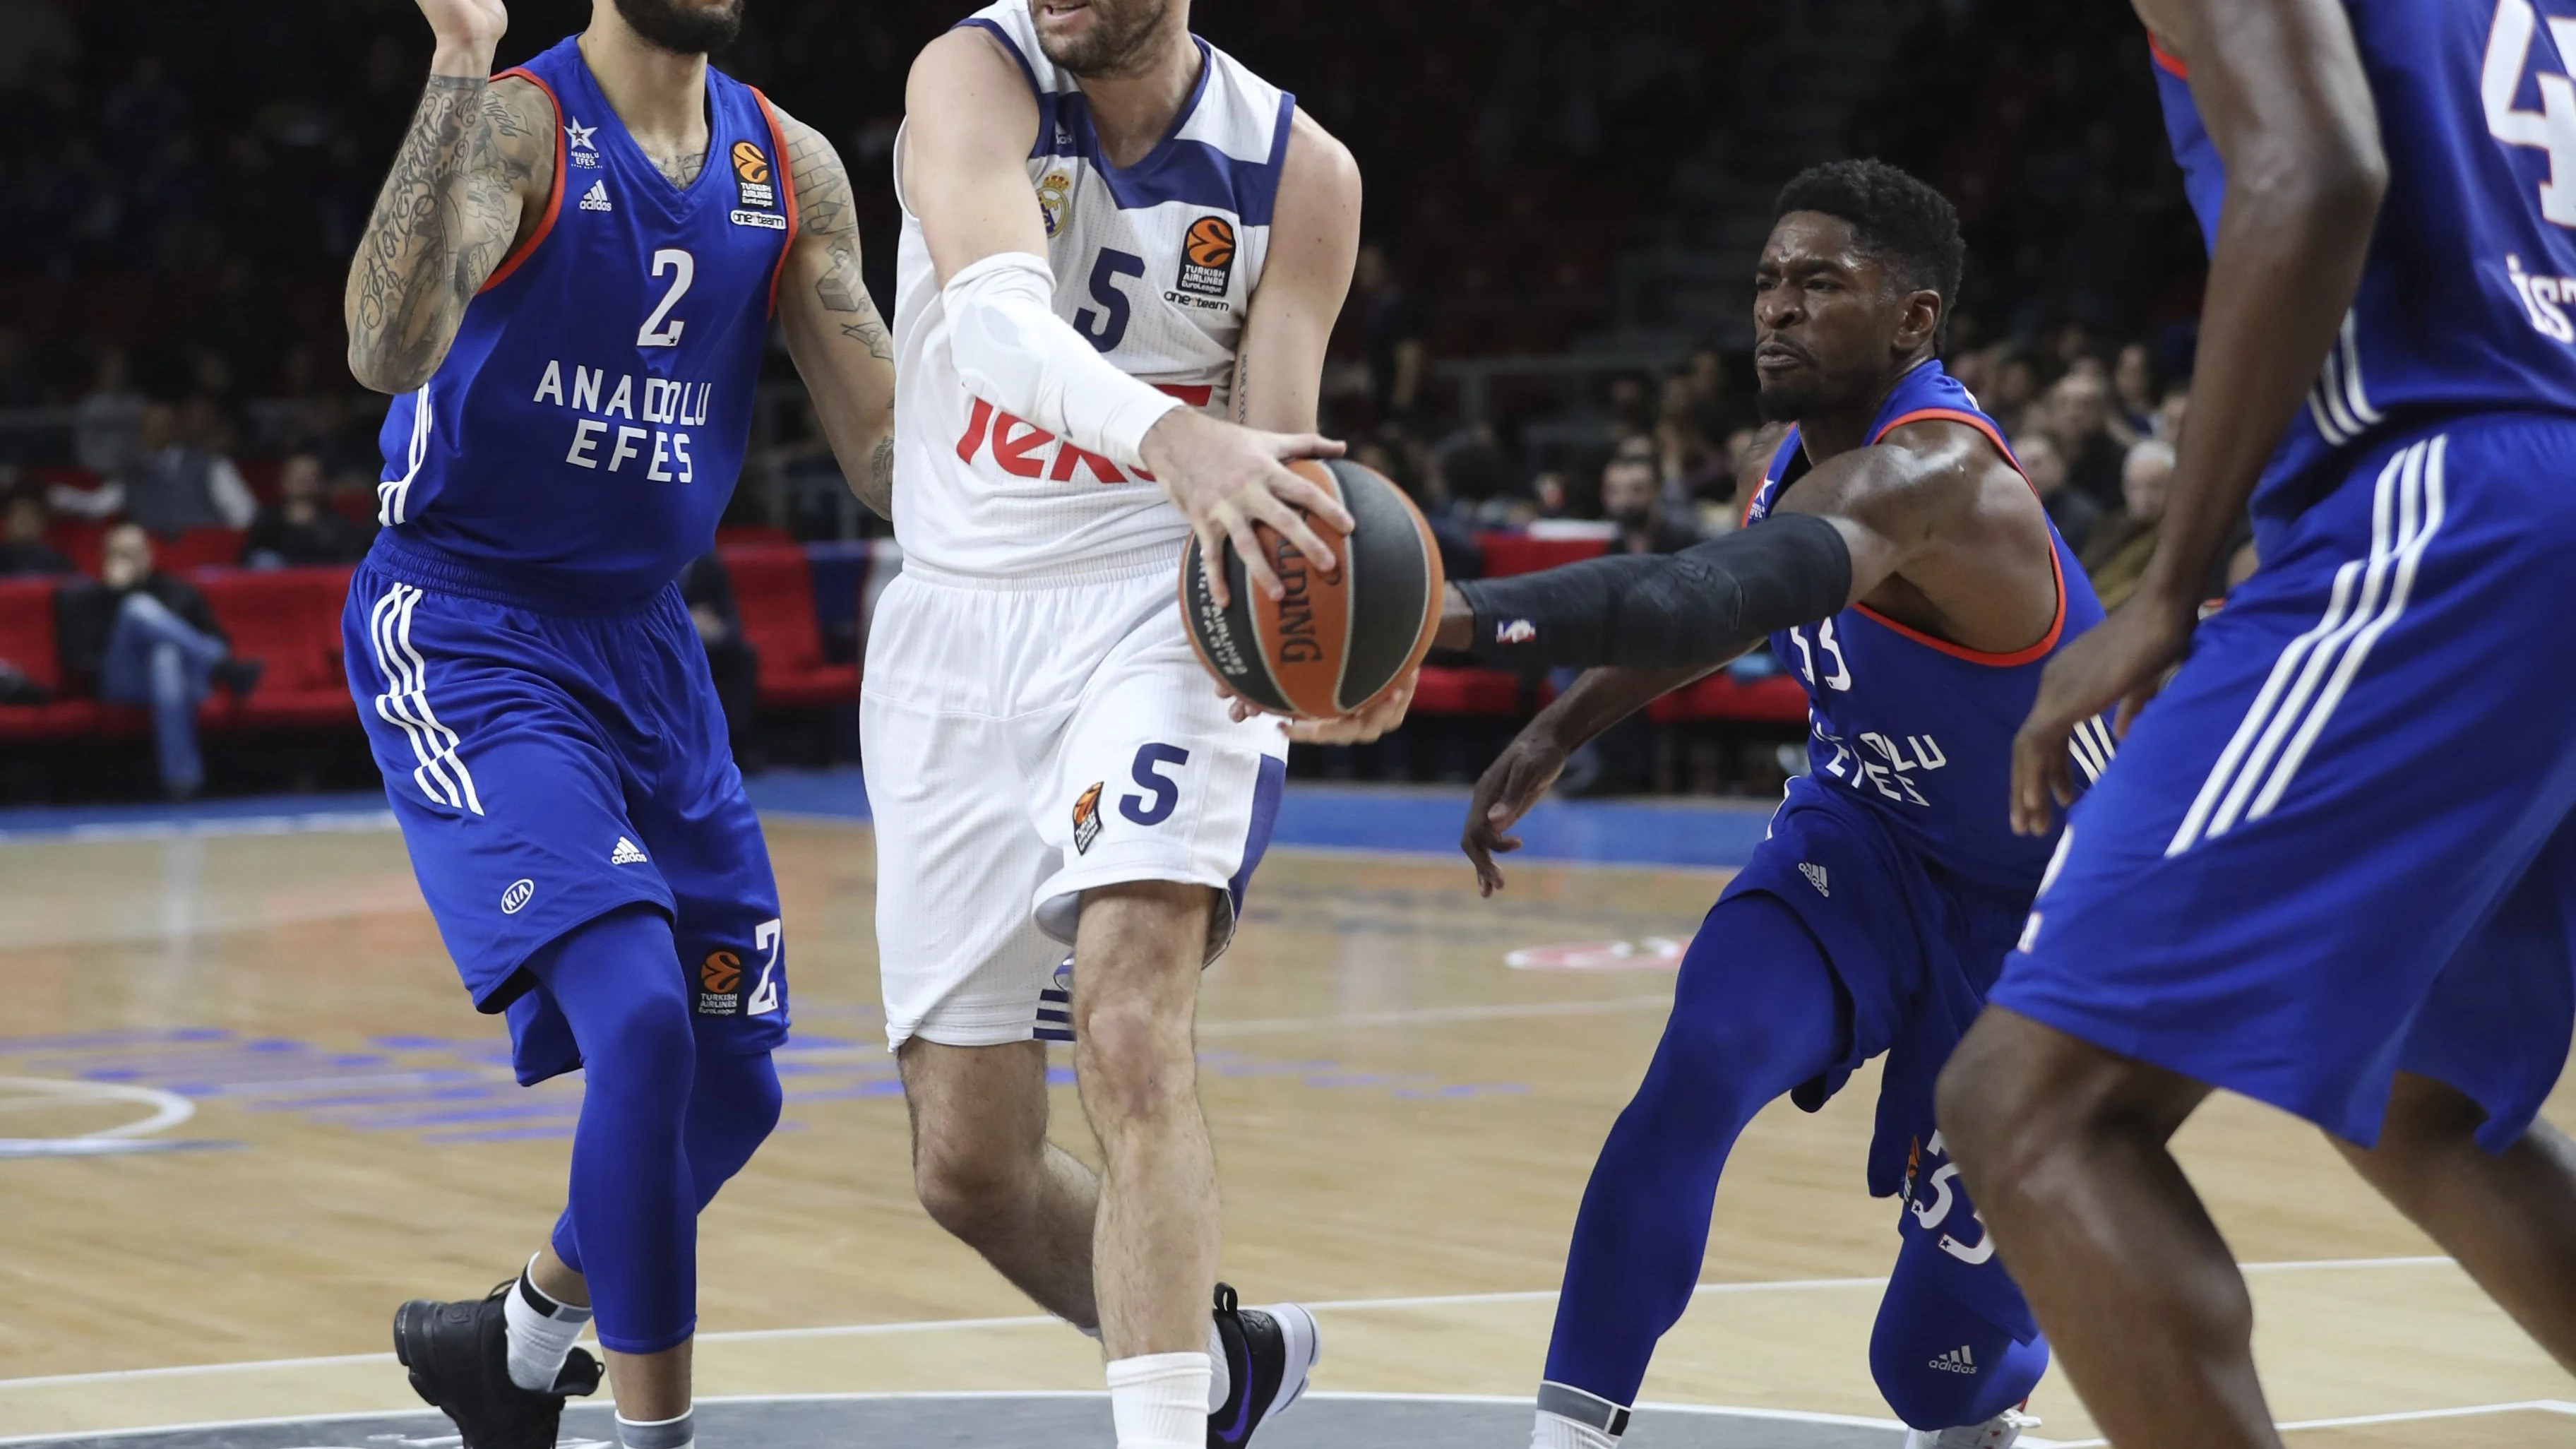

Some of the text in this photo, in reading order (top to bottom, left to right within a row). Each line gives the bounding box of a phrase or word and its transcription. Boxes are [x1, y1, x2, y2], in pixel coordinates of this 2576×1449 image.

[576, 157, 595, 166] EFES
[740, 182, 772, 192] TURKISH
[741, 190, 773, 200] AIRLINES
[579, 198, 612, 212] adidas
[1183, 273, 1224, 286] AIRLINES
[1185, 264, 1225, 279] TURKISH
[637, 249, 693, 346] 2
[1073, 246, 1145, 353] 5
[533, 359, 711, 426] ANADOLU
[566, 419, 693, 483] EFES
[1277, 519, 1323, 664] LDING
[1119, 743, 1190, 825] 5
[612, 852, 648, 865] adidas
[1798, 862, 1830, 898] adidas
[504, 884, 530, 910] KIA
[747, 918, 781, 1015] 2
[1928, 1359, 1978, 1373] adidas
